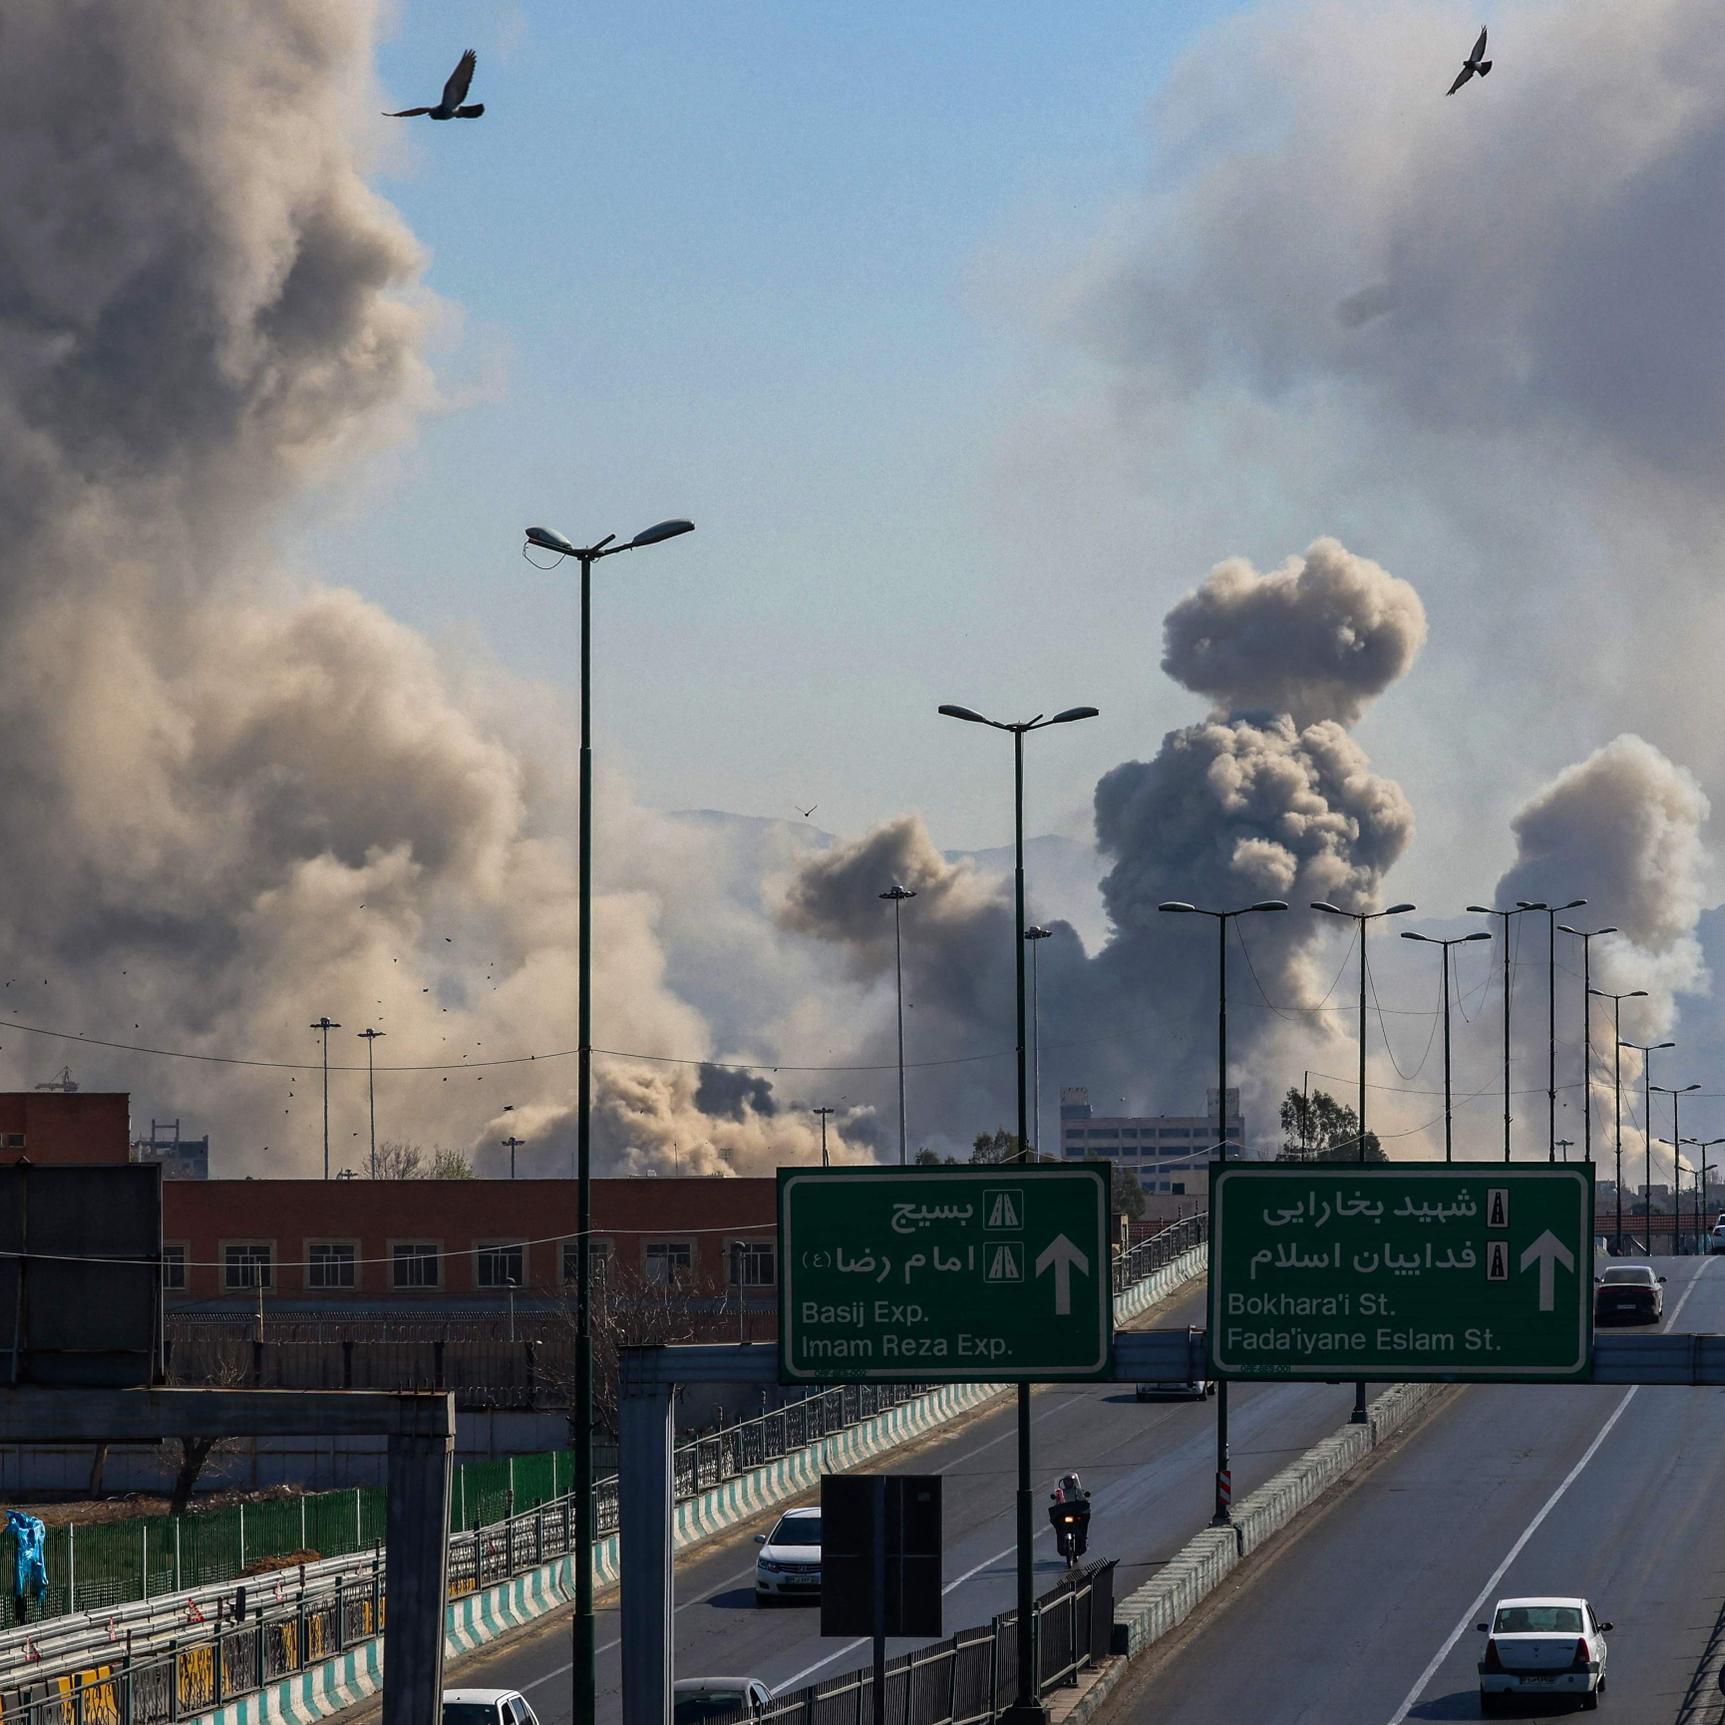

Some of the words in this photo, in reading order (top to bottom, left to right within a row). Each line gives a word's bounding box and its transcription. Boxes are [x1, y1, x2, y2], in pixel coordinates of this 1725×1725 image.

[891, 1201, 973, 1234] بسیج
[1263, 1191, 1384, 1228] بخارایی
[1393, 1189, 1477, 1223] شهید
[836, 1247, 891, 1283] رضا
[904, 1245, 974, 1284] امام
[1250, 1242, 1340, 1280] اسلام
[1353, 1241, 1476, 1276] فداییان
[802, 1302, 864, 1327] Basij
[874, 1301, 928, 1326] Exp.
[1228, 1293, 1350, 1315] Bokhara'i
[1359, 1293, 1395, 1315] St.
[802, 1336, 872, 1357] Imam
[883, 1334, 948, 1356] Reza
[958, 1333, 1013, 1359] Exp.
[1227, 1328, 1366, 1354] Fada'iyane
[1377, 1328, 1454, 1350] Eslam
[1464, 1328, 1501, 1350] St.
